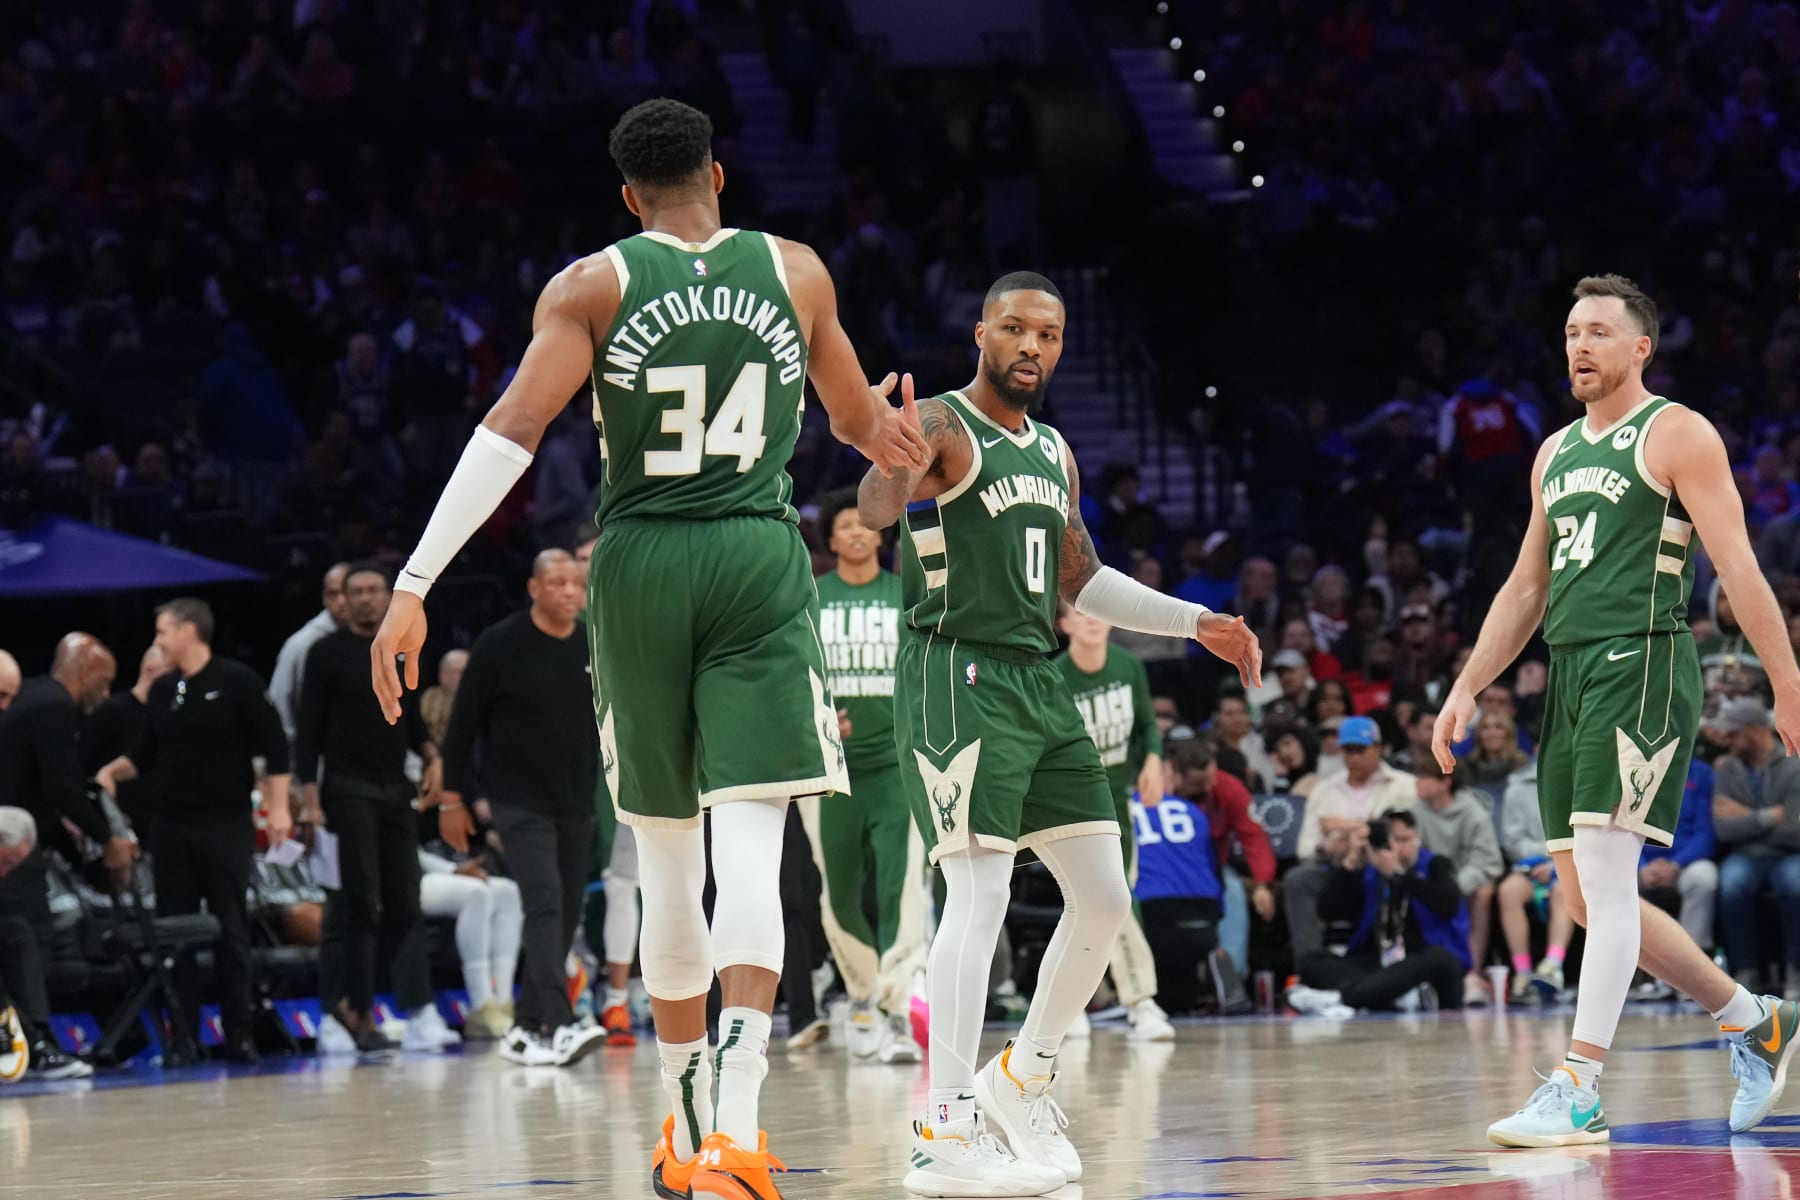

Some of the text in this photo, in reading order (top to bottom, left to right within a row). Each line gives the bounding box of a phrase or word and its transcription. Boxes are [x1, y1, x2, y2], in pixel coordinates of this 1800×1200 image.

[603, 285, 802, 391] ANTETOKOUNMPO
[644, 362, 767, 477] 34
[978, 474, 1069, 528] MILWAUKE
[1025, 527, 1047, 593] 0
[1552, 511, 1598, 571] 24
[1130, 799, 1197, 847] 16
[698, 1148, 721, 1166] 34
